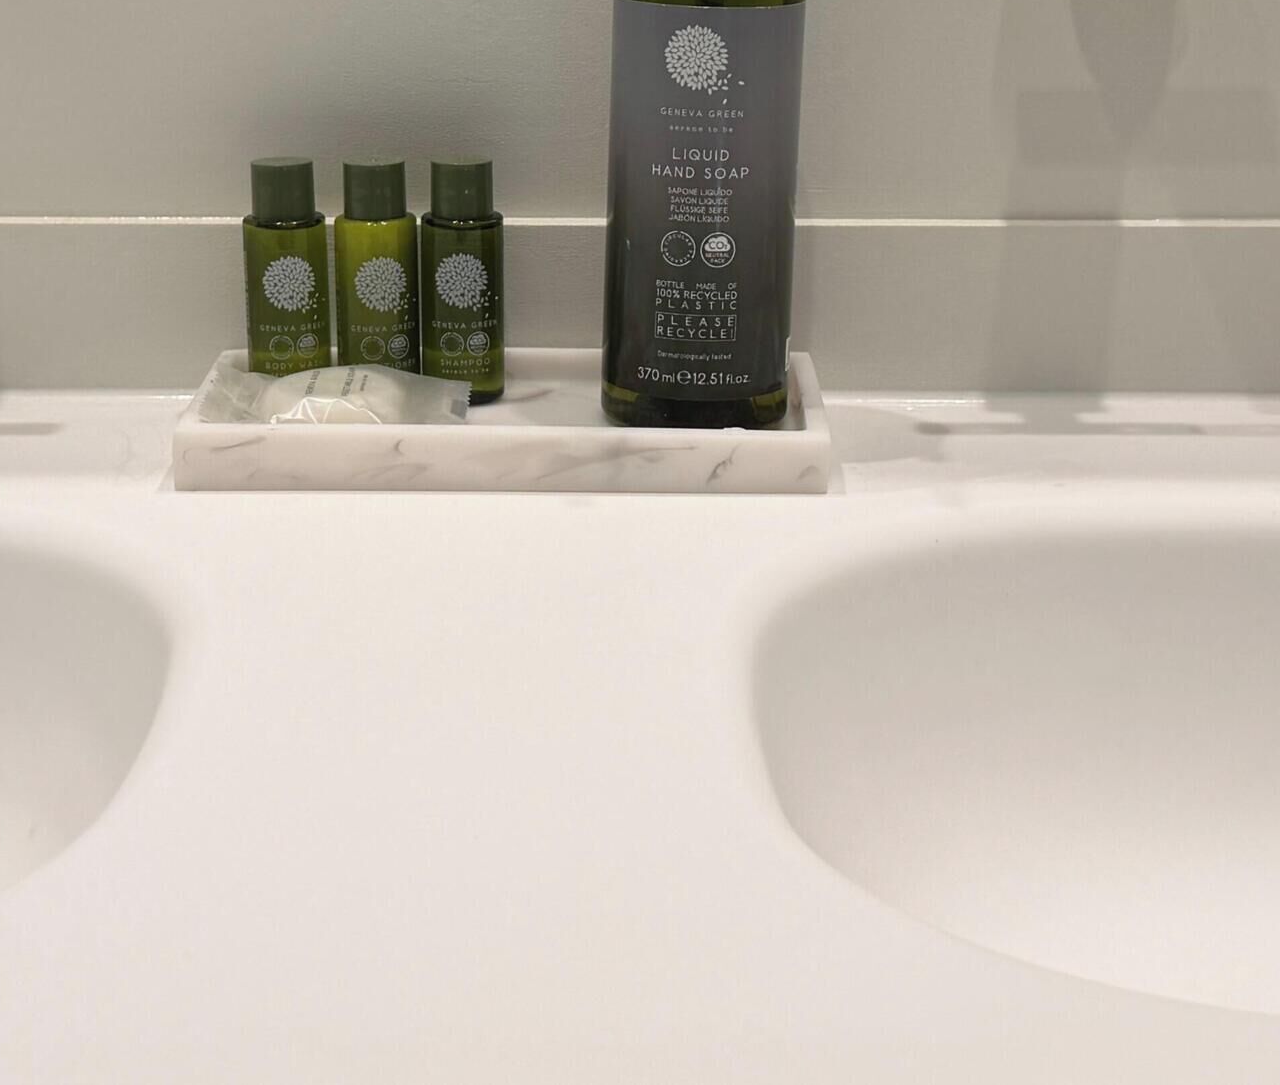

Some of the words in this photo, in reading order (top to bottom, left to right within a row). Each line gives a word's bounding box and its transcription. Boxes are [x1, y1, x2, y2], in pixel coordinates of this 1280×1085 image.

[660, 106, 703, 117] GENEVA
[708, 109, 744, 118] GREEN
[672, 147, 730, 162] LIQUID
[651, 164, 695, 179] HAND
[704, 167, 750, 180] SOAP
[671, 195, 697, 204] SAVON
[655, 279, 685, 289] BOTTLE
[696, 282, 717, 290] MADE
[727, 282, 737, 290] OF
[656, 288, 681, 298] 100%
[683, 290, 738, 301] RECYCLED
[655, 297, 737, 311] PLASTIC
[432, 318, 467, 329] GENEVA
[657, 314, 735, 327] PLEASE
[656, 326, 734, 339] RECYCLE!
[265, 361, 293, 370] BODY
[440, 357, 490, 368] SHAMPOO
[637, 366, 660, 382] 370
[662, 373, 675, 383] ml
